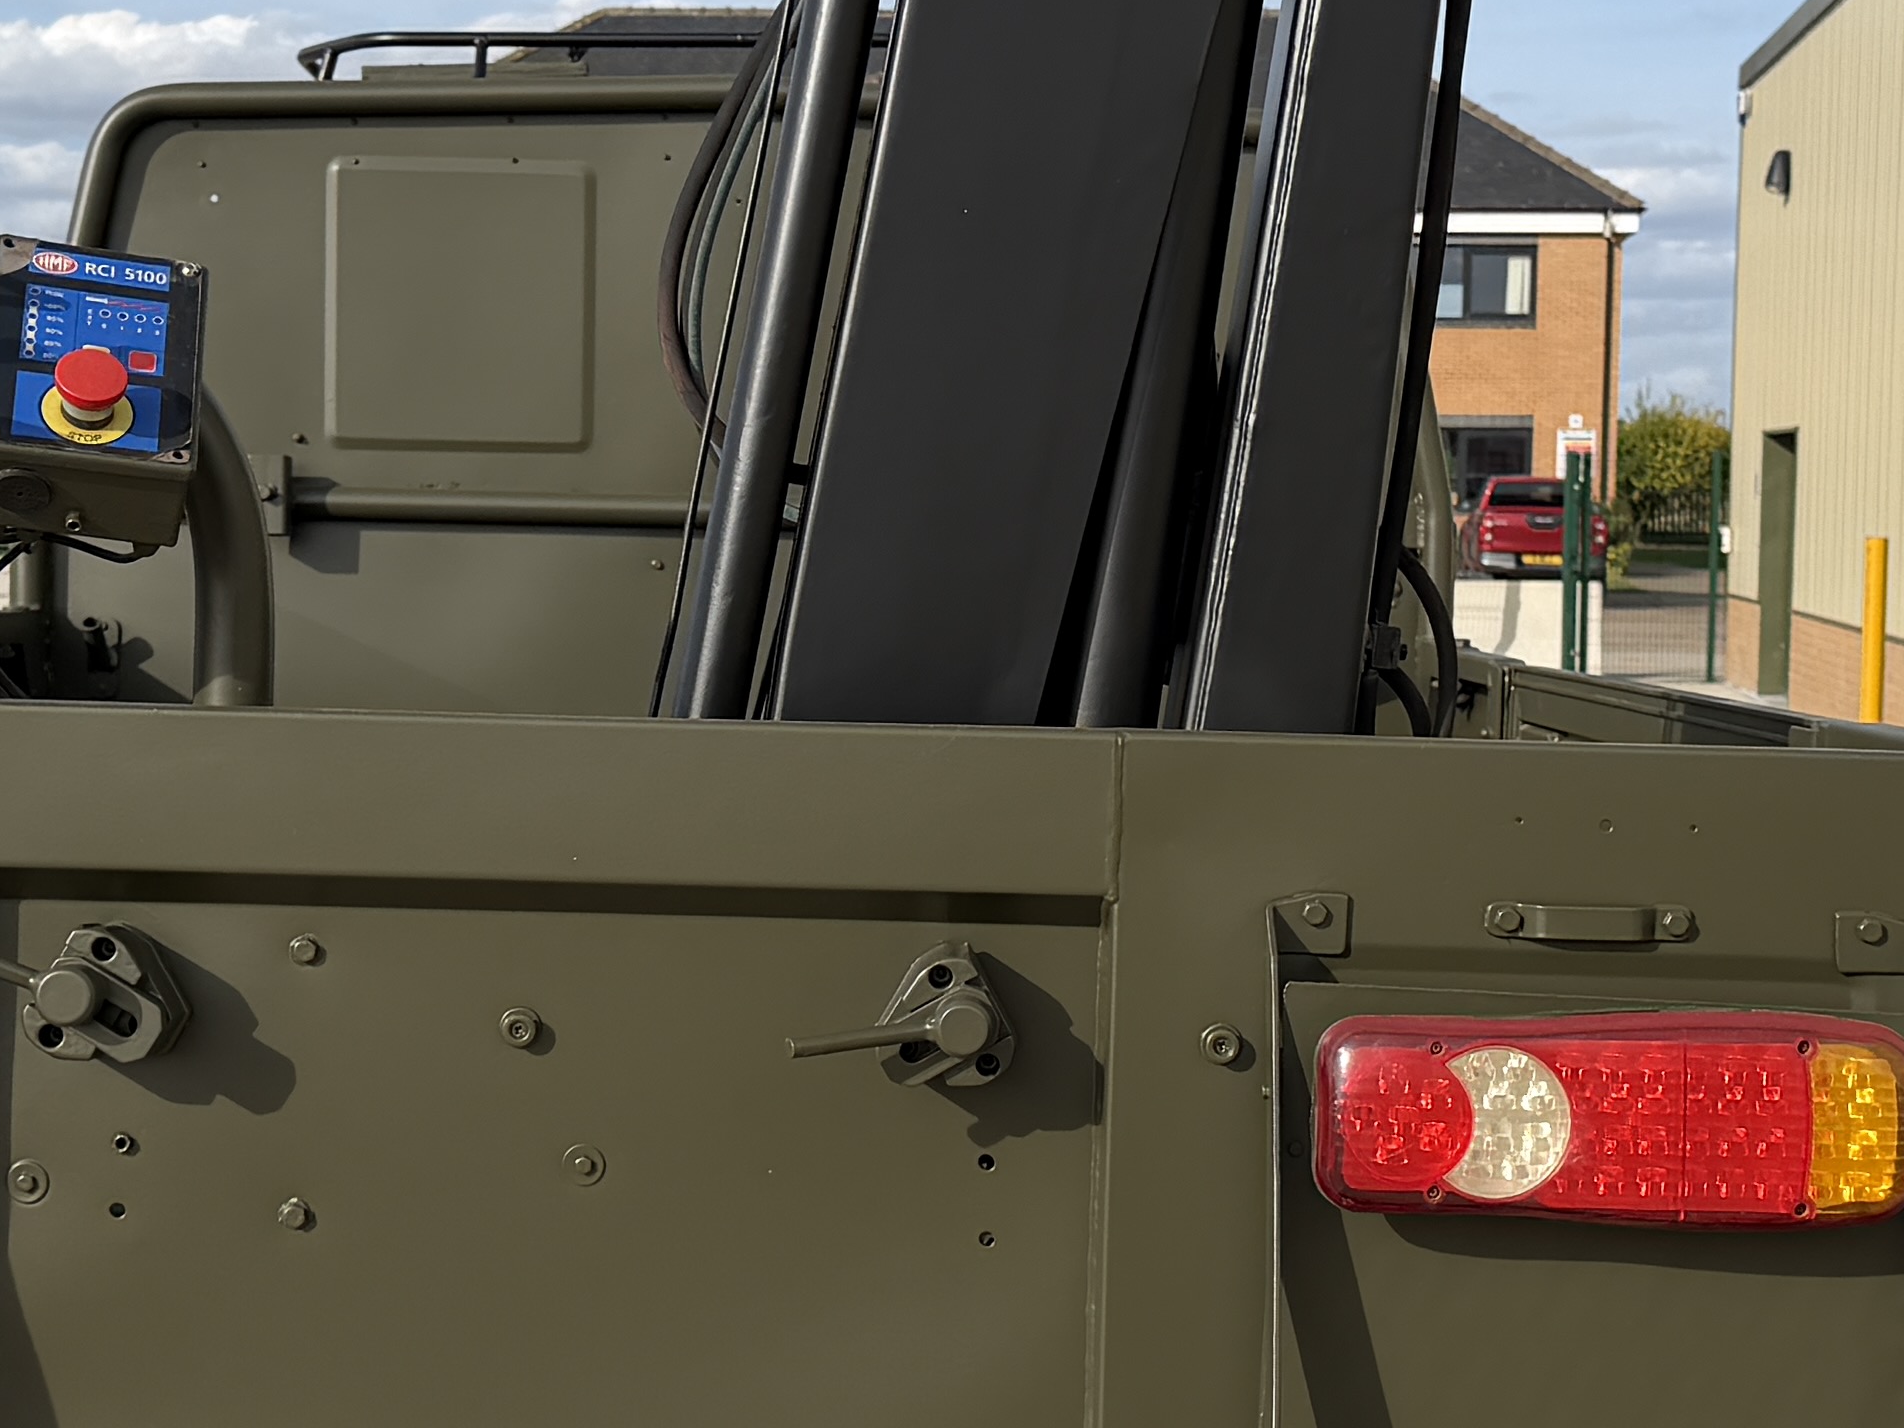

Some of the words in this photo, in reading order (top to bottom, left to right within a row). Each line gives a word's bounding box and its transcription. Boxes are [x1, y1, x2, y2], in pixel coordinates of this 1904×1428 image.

[38, 253, 74, 272] HMF
[85, 262, 115, 278] RCI
[124, 268, 167, 285] 5100
[67, 431, 103, 442] STOP
